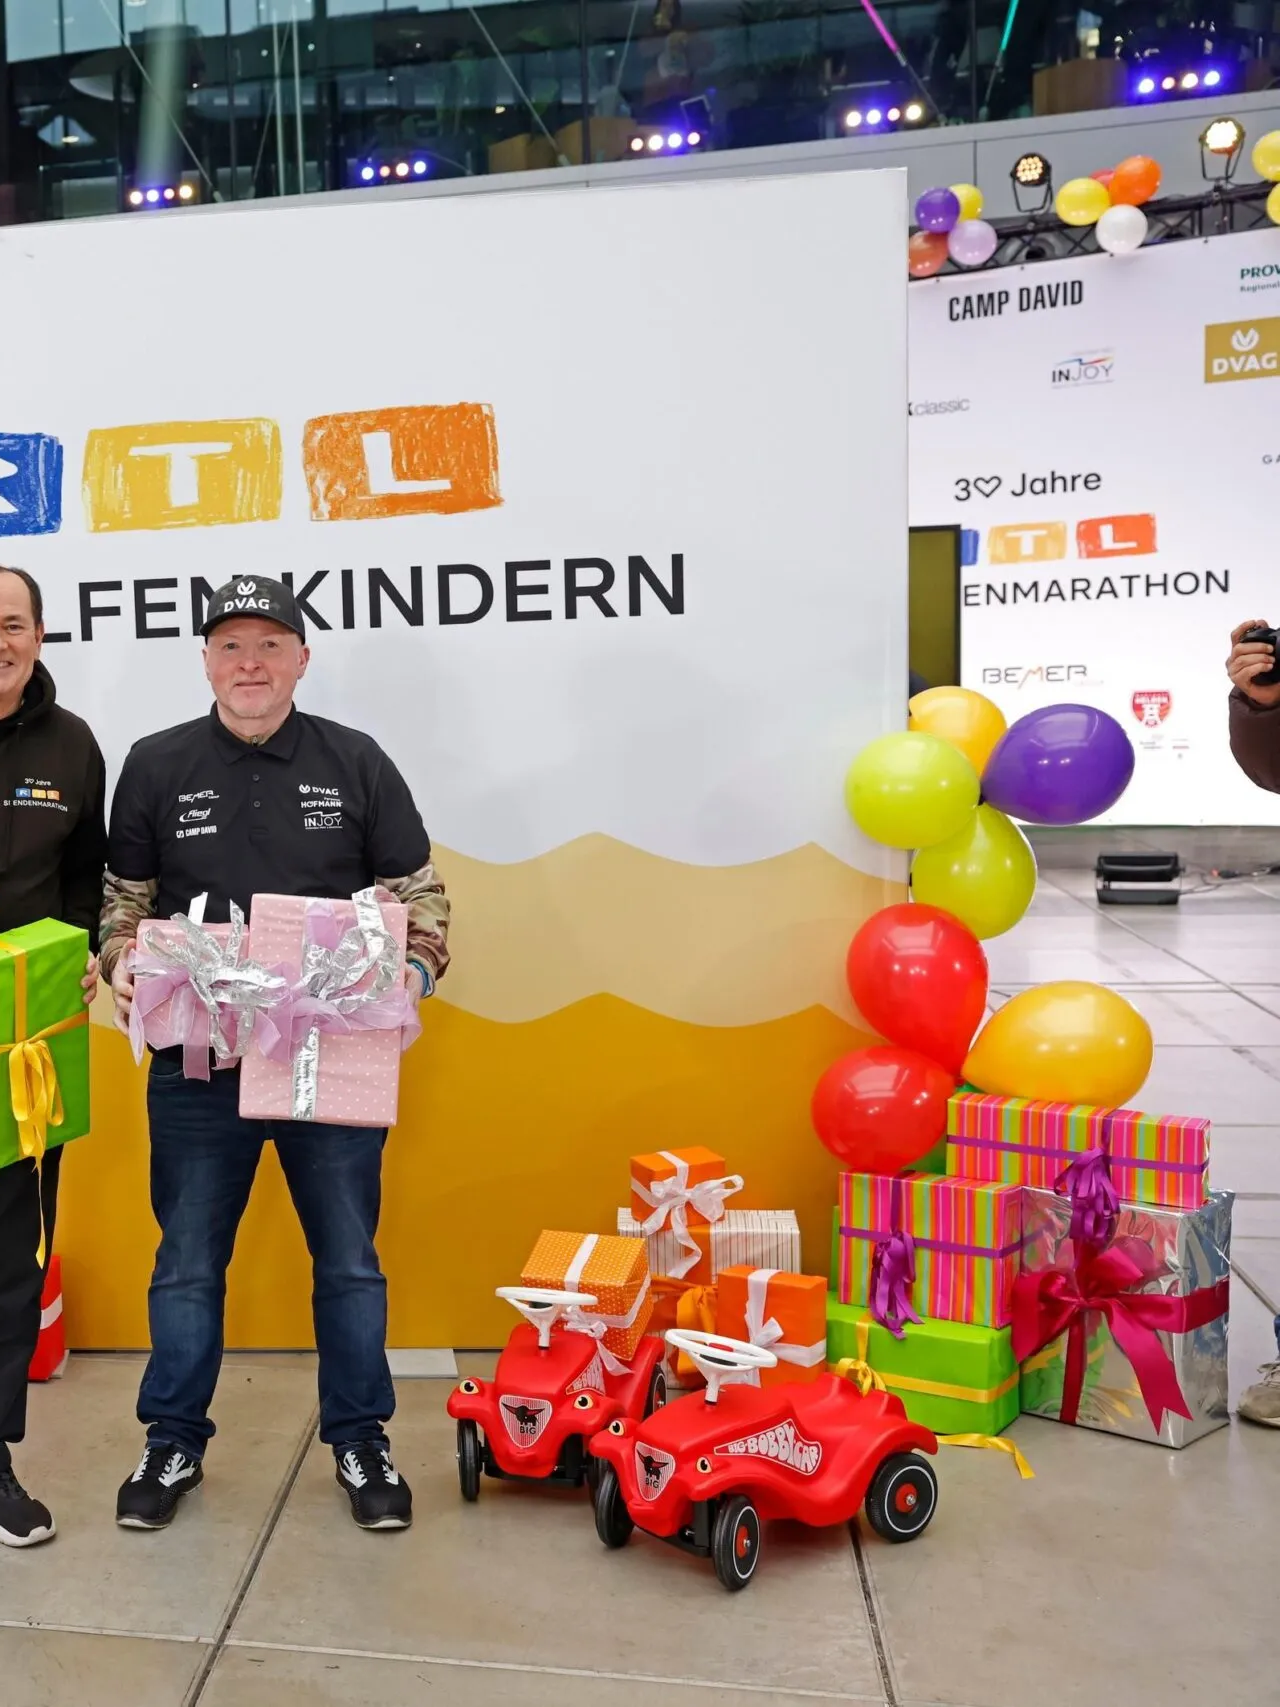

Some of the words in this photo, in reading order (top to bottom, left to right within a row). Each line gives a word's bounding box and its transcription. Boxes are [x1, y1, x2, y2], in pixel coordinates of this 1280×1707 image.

[948, 290, 1010, 322] CAMP
[1018, 280, 1084, 313] DAVID
[1052, 363, 1114, 382] INJOY
[1212, 352, 1278, 376] DVAG
[1011, 471, 1102, 497] Jahre
[281, 553, 684, 631] KINDERN
[964, 569, 1230, 607] ENMARATHON
[223, 597, 270, 612] DVAG
[983, 665, 1087, 690] BEMER
[312, 786, 339, 796] DVAG
[304, 816, 342, 827] INJOY
[520, 1425, 537, 1435] BIG
[645, 1477, 660, 1489] BIG
